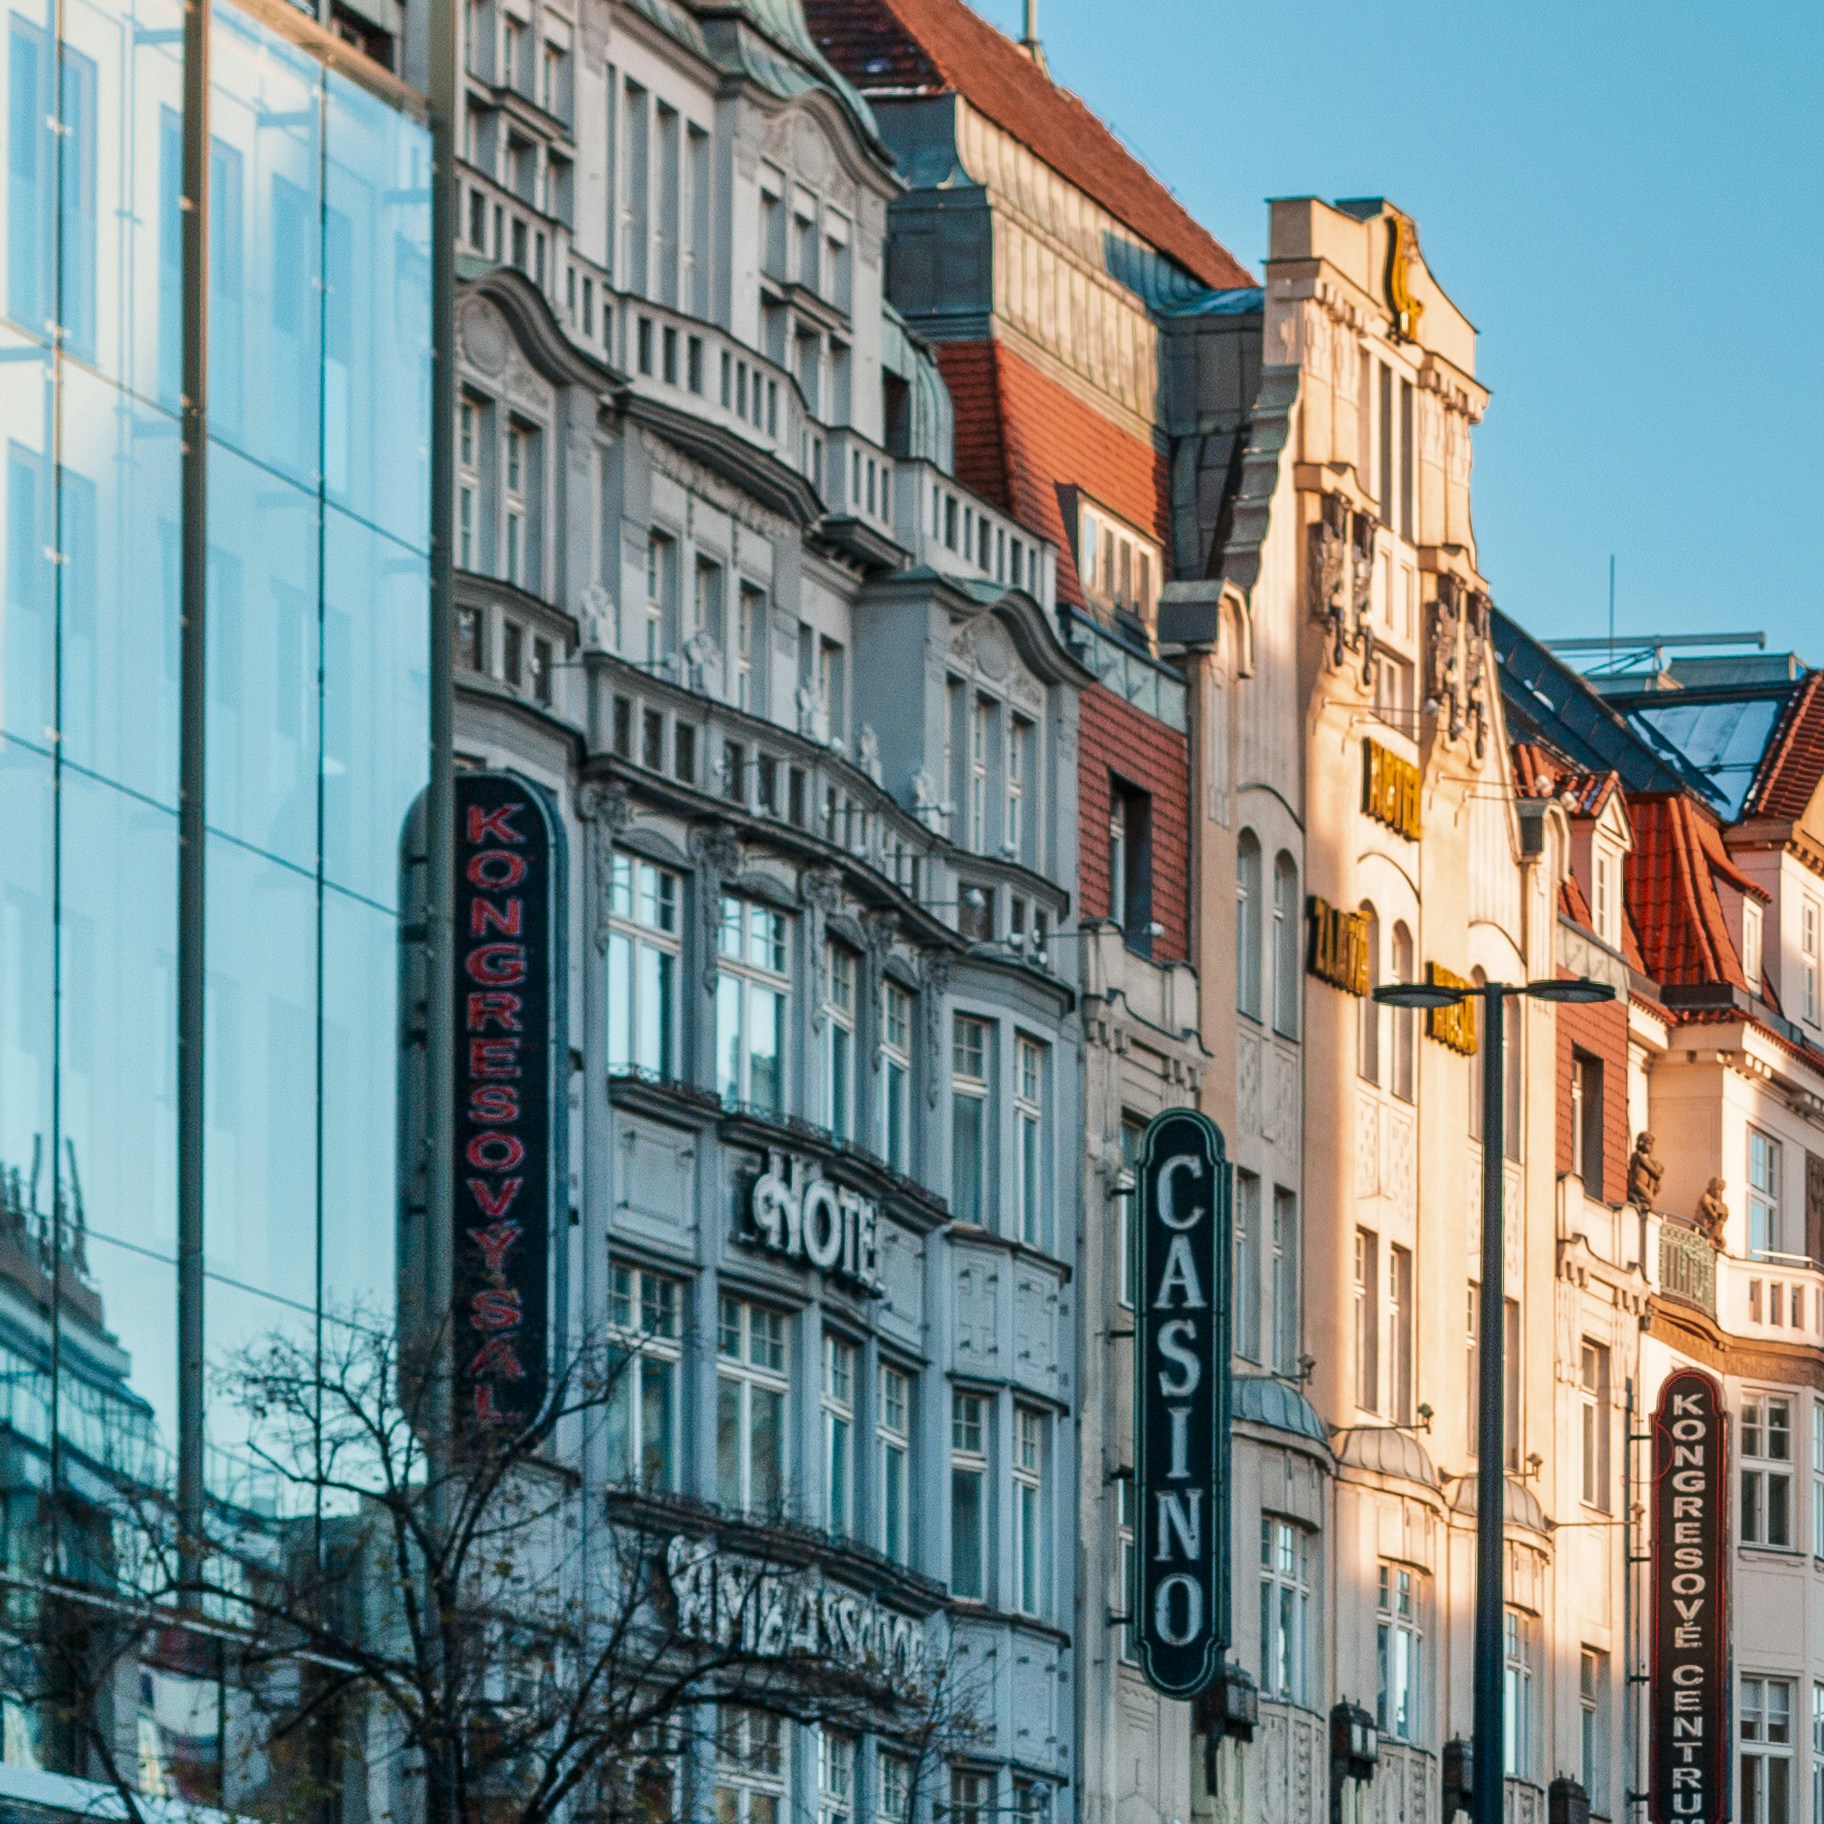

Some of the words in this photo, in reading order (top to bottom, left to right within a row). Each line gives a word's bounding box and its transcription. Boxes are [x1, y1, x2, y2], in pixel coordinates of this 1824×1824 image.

[752, 1150, 887, 1291] HOTEL
[1152, 1153, 1207, 1648] CASINO
[1670, 1392, 1707, 1649] KONGRESOVÉ
